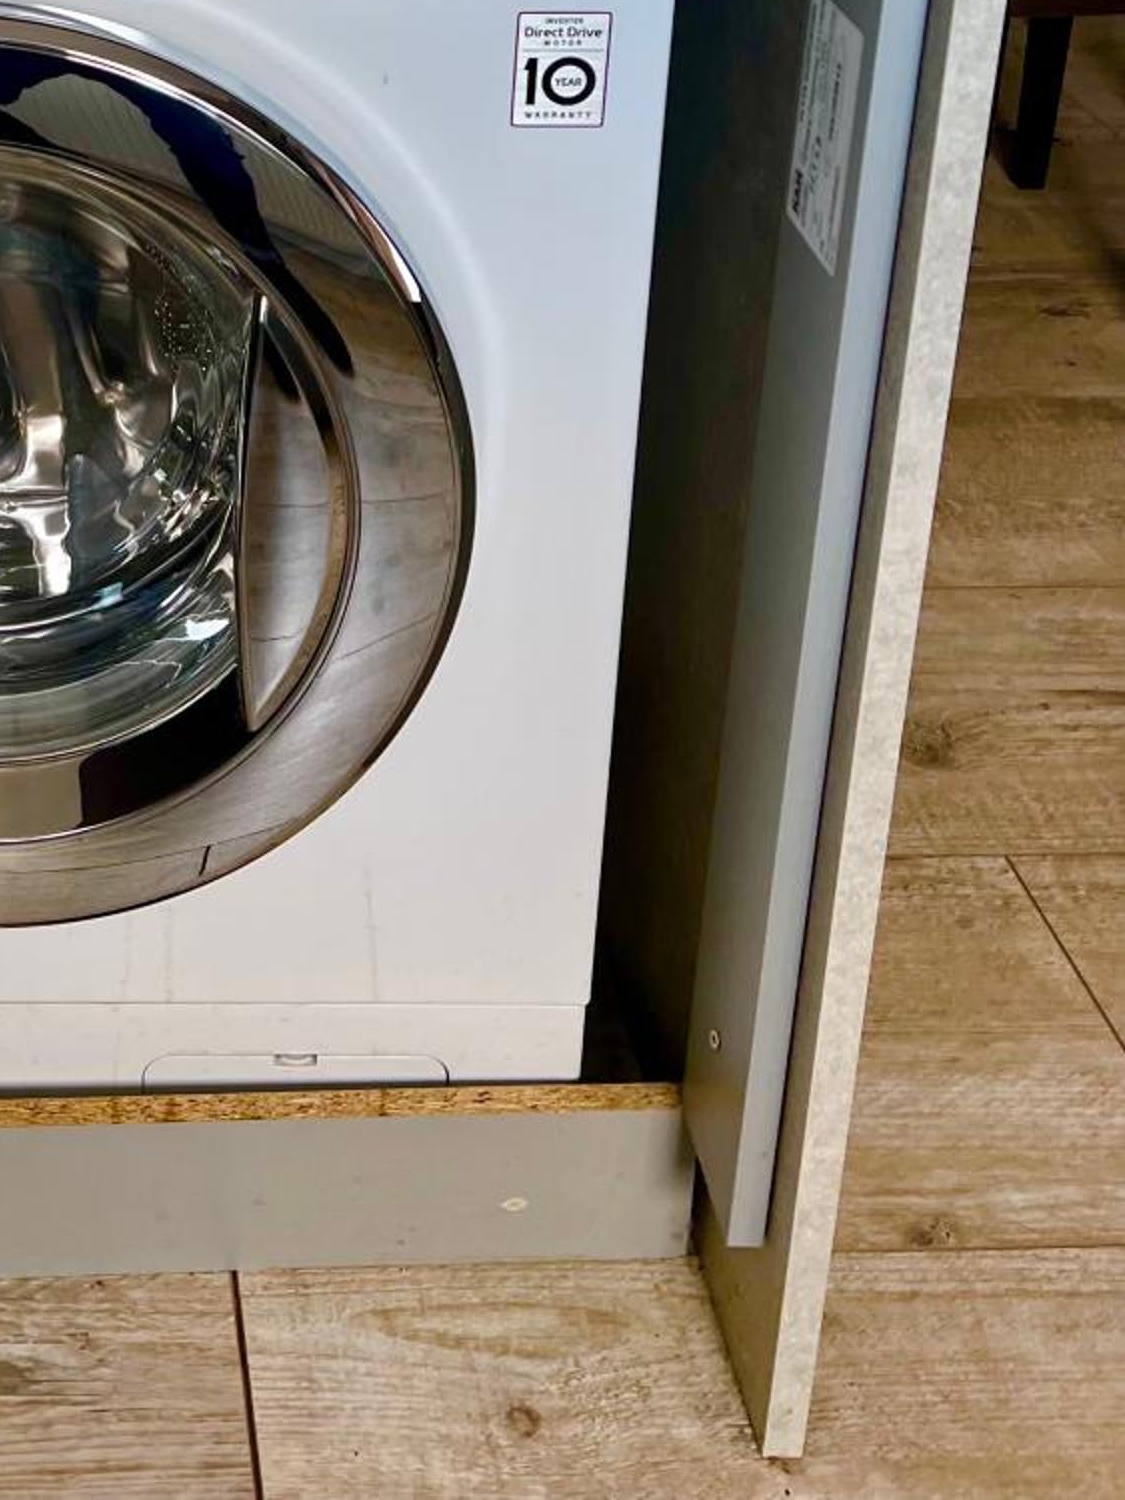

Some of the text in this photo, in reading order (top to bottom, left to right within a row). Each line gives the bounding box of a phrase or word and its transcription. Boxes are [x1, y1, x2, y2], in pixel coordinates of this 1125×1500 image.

[524, 25, 603, 38] Direct Drive
[523, 55, 597, 107] 10
[554, 77, 584, 88] YEAR
[524, 111, 592, 120] WARRANTY
